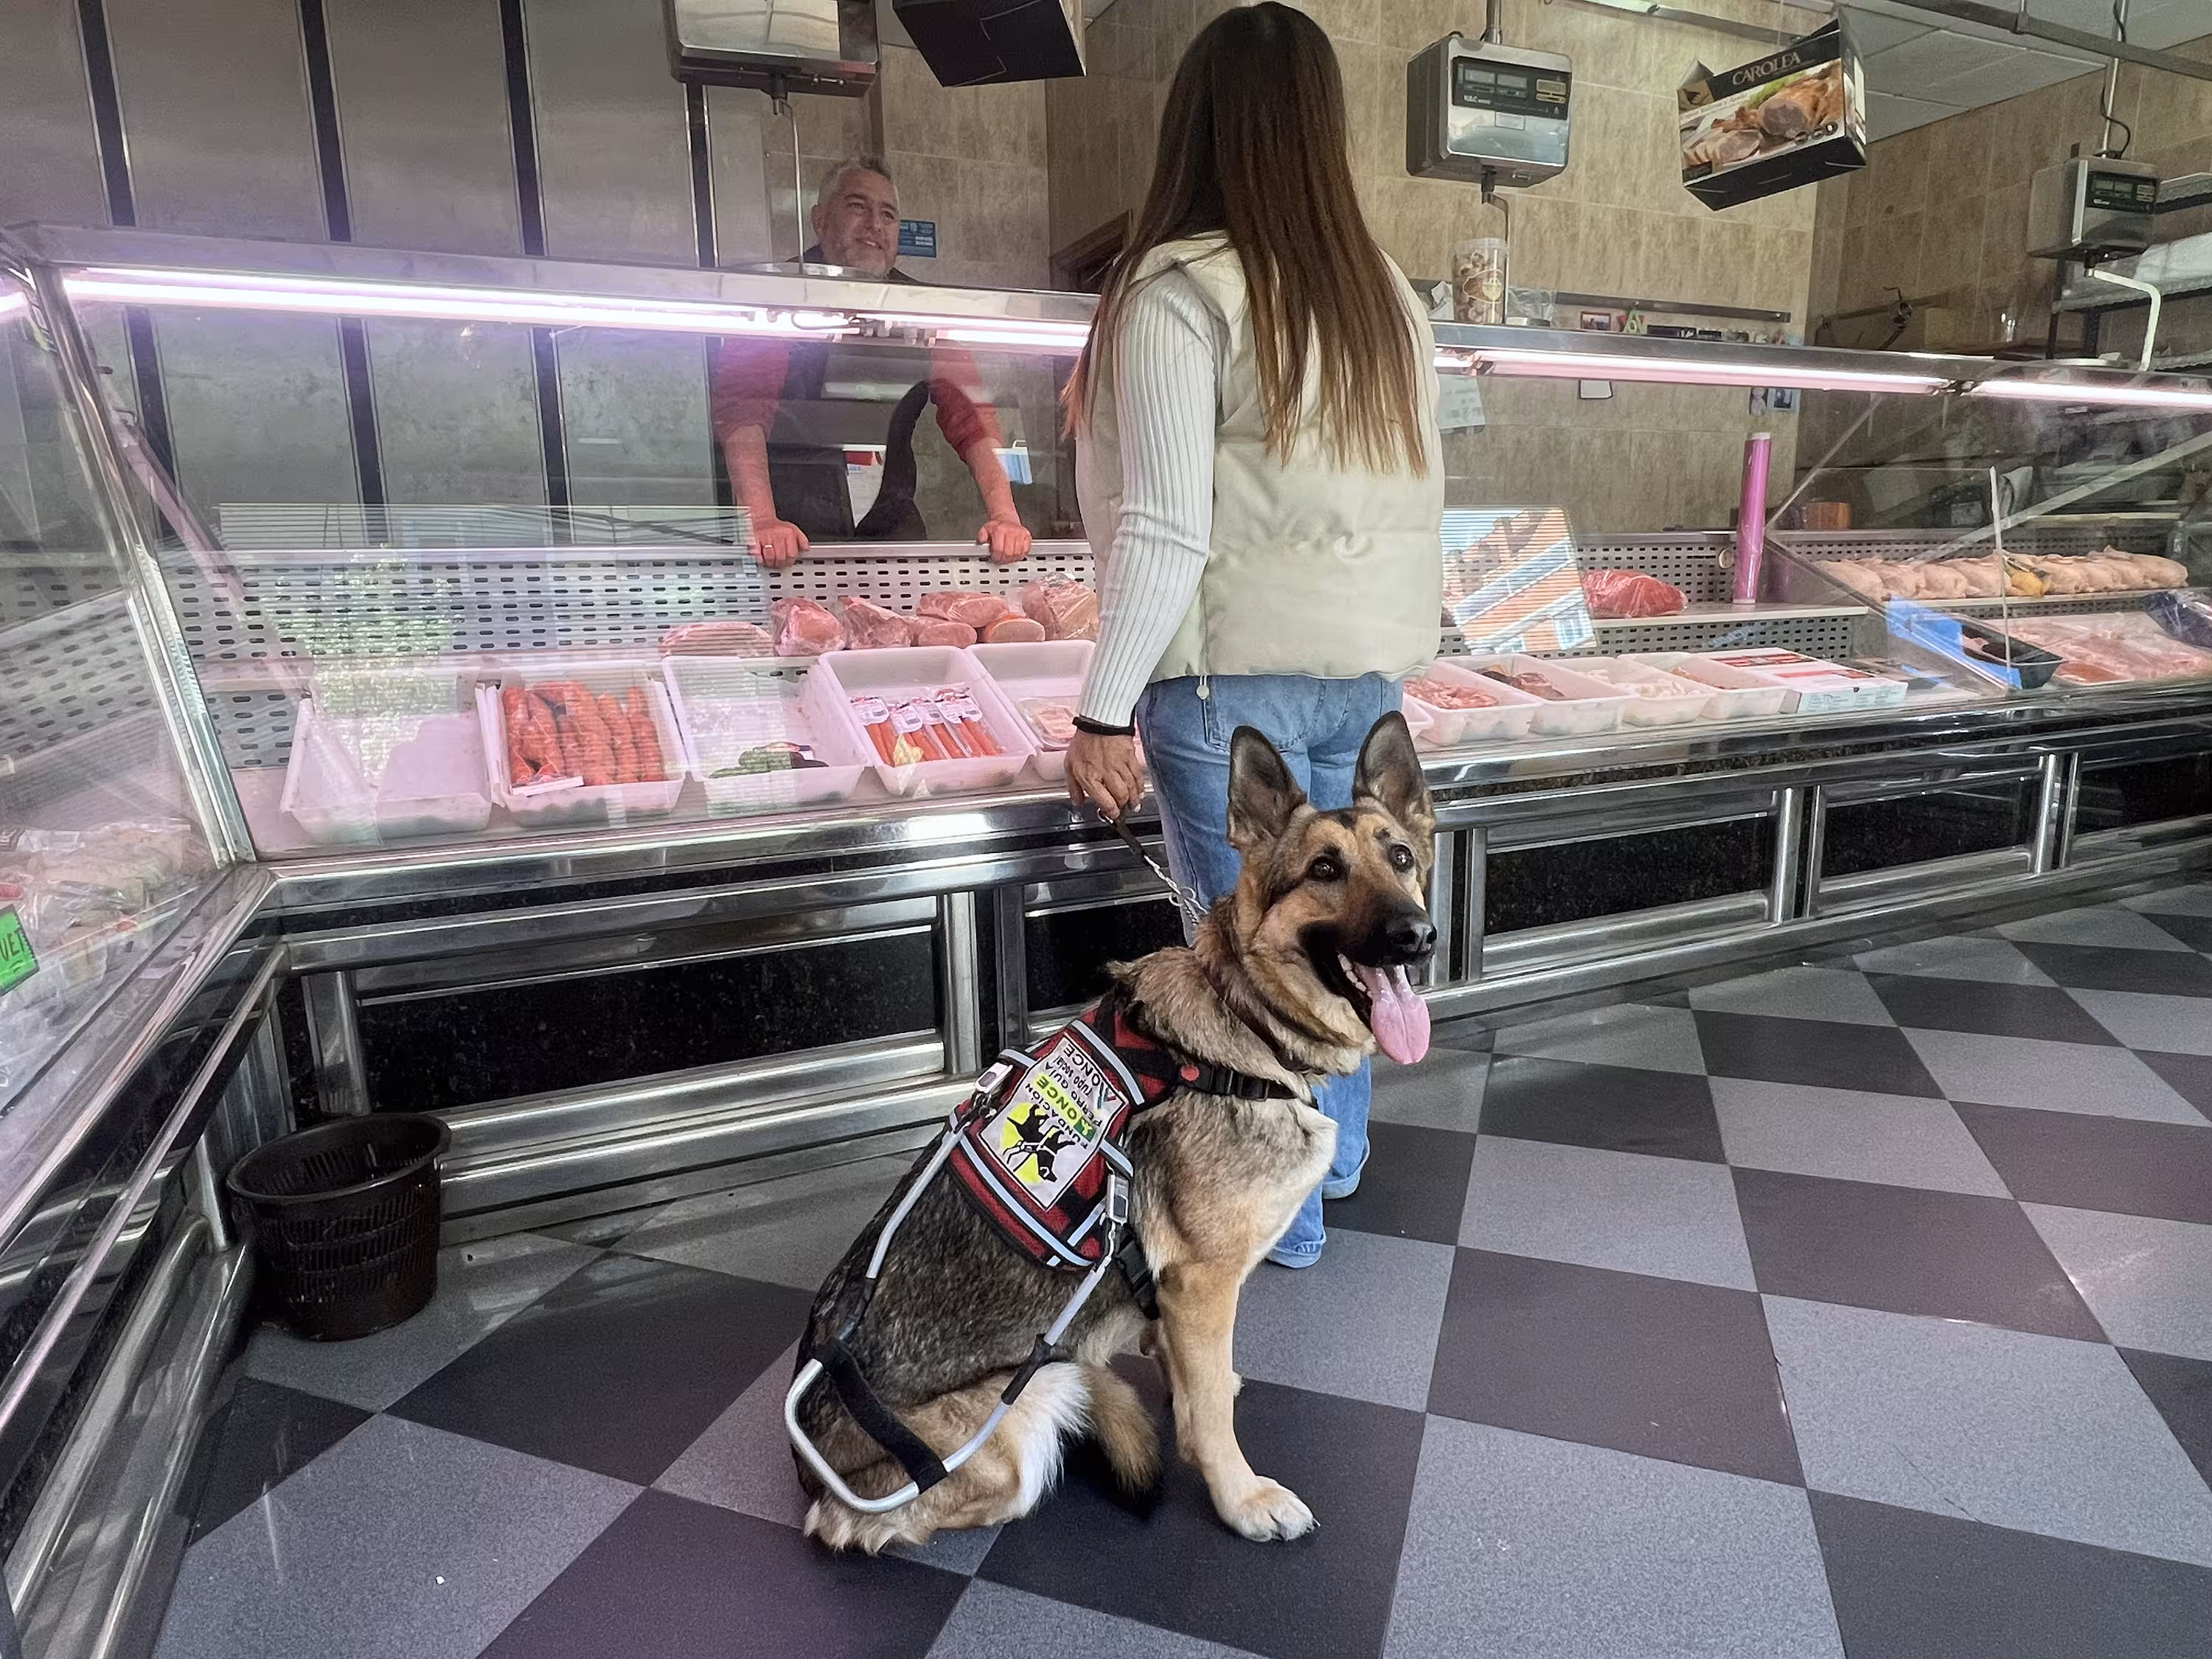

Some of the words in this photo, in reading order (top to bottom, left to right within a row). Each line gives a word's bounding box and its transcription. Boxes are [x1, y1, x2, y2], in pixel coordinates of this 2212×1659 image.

[1064, 1044, 1100, 1085] ONCE
[1025, 1083, 1088, 1150] FUNDACIÓN
[1036, 1076, 1077, 1120] ONCE
[1071, 1091, 1102, 1126] PERRO
